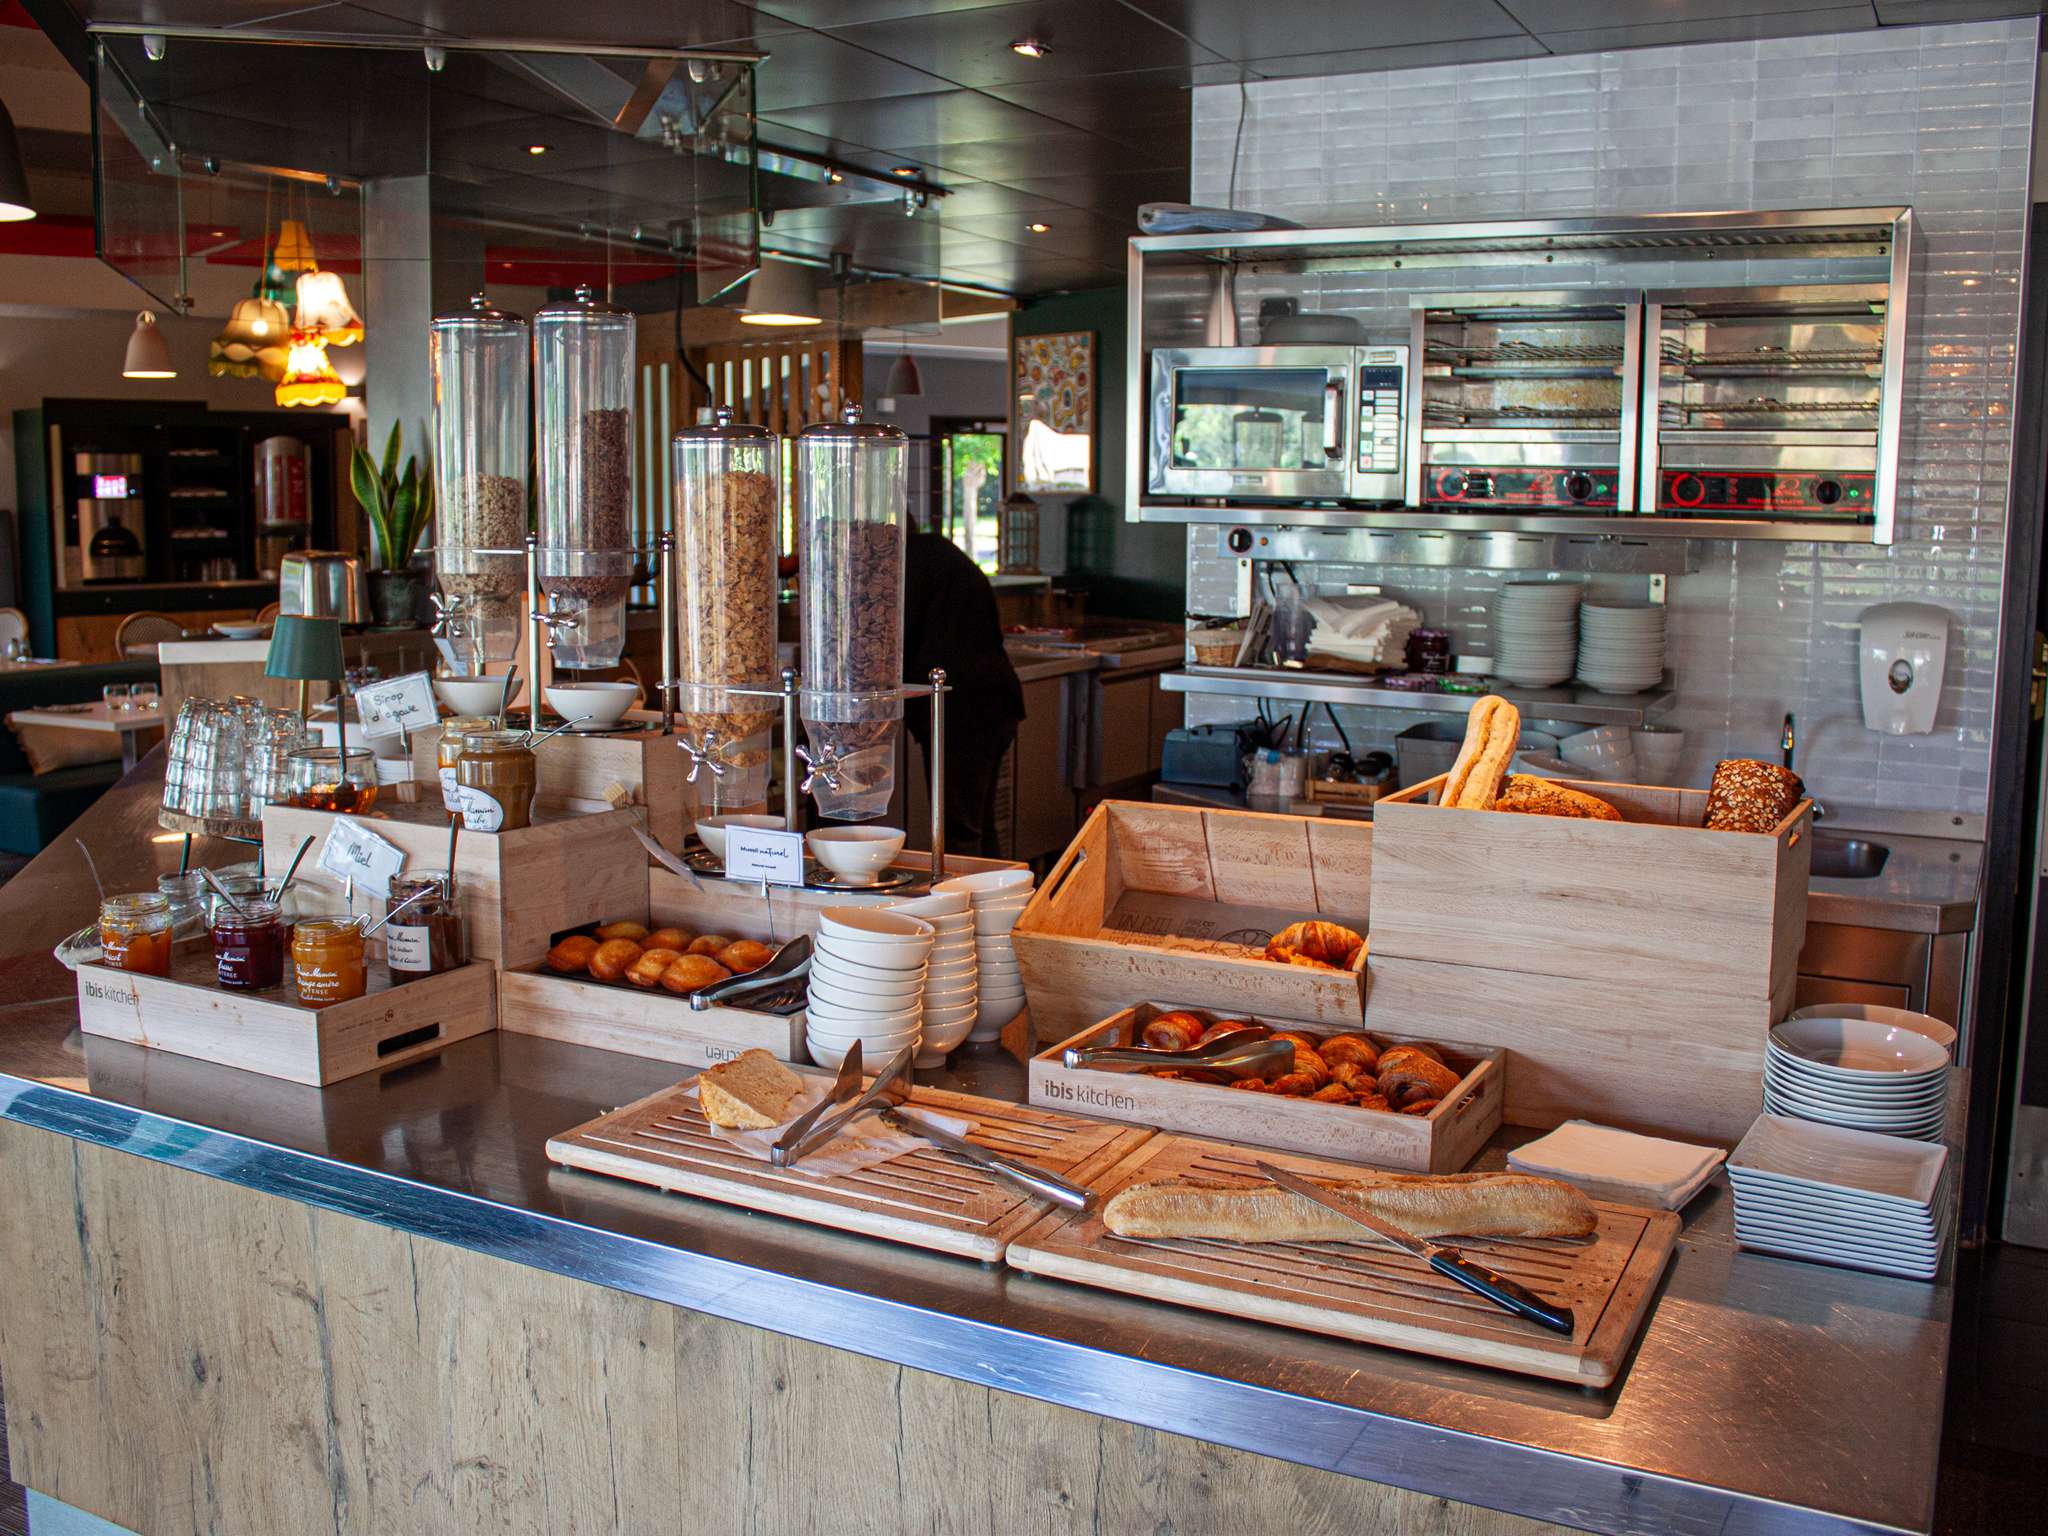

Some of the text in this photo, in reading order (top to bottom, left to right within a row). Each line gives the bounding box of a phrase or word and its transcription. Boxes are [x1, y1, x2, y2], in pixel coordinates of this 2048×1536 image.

[373, 692, 404, 706] Sirop
[346, 841, 373, 868] Miel
[84, 980, 104, 998] ibis
[1044, 1079, 1135, 1111] ibis kitchen
